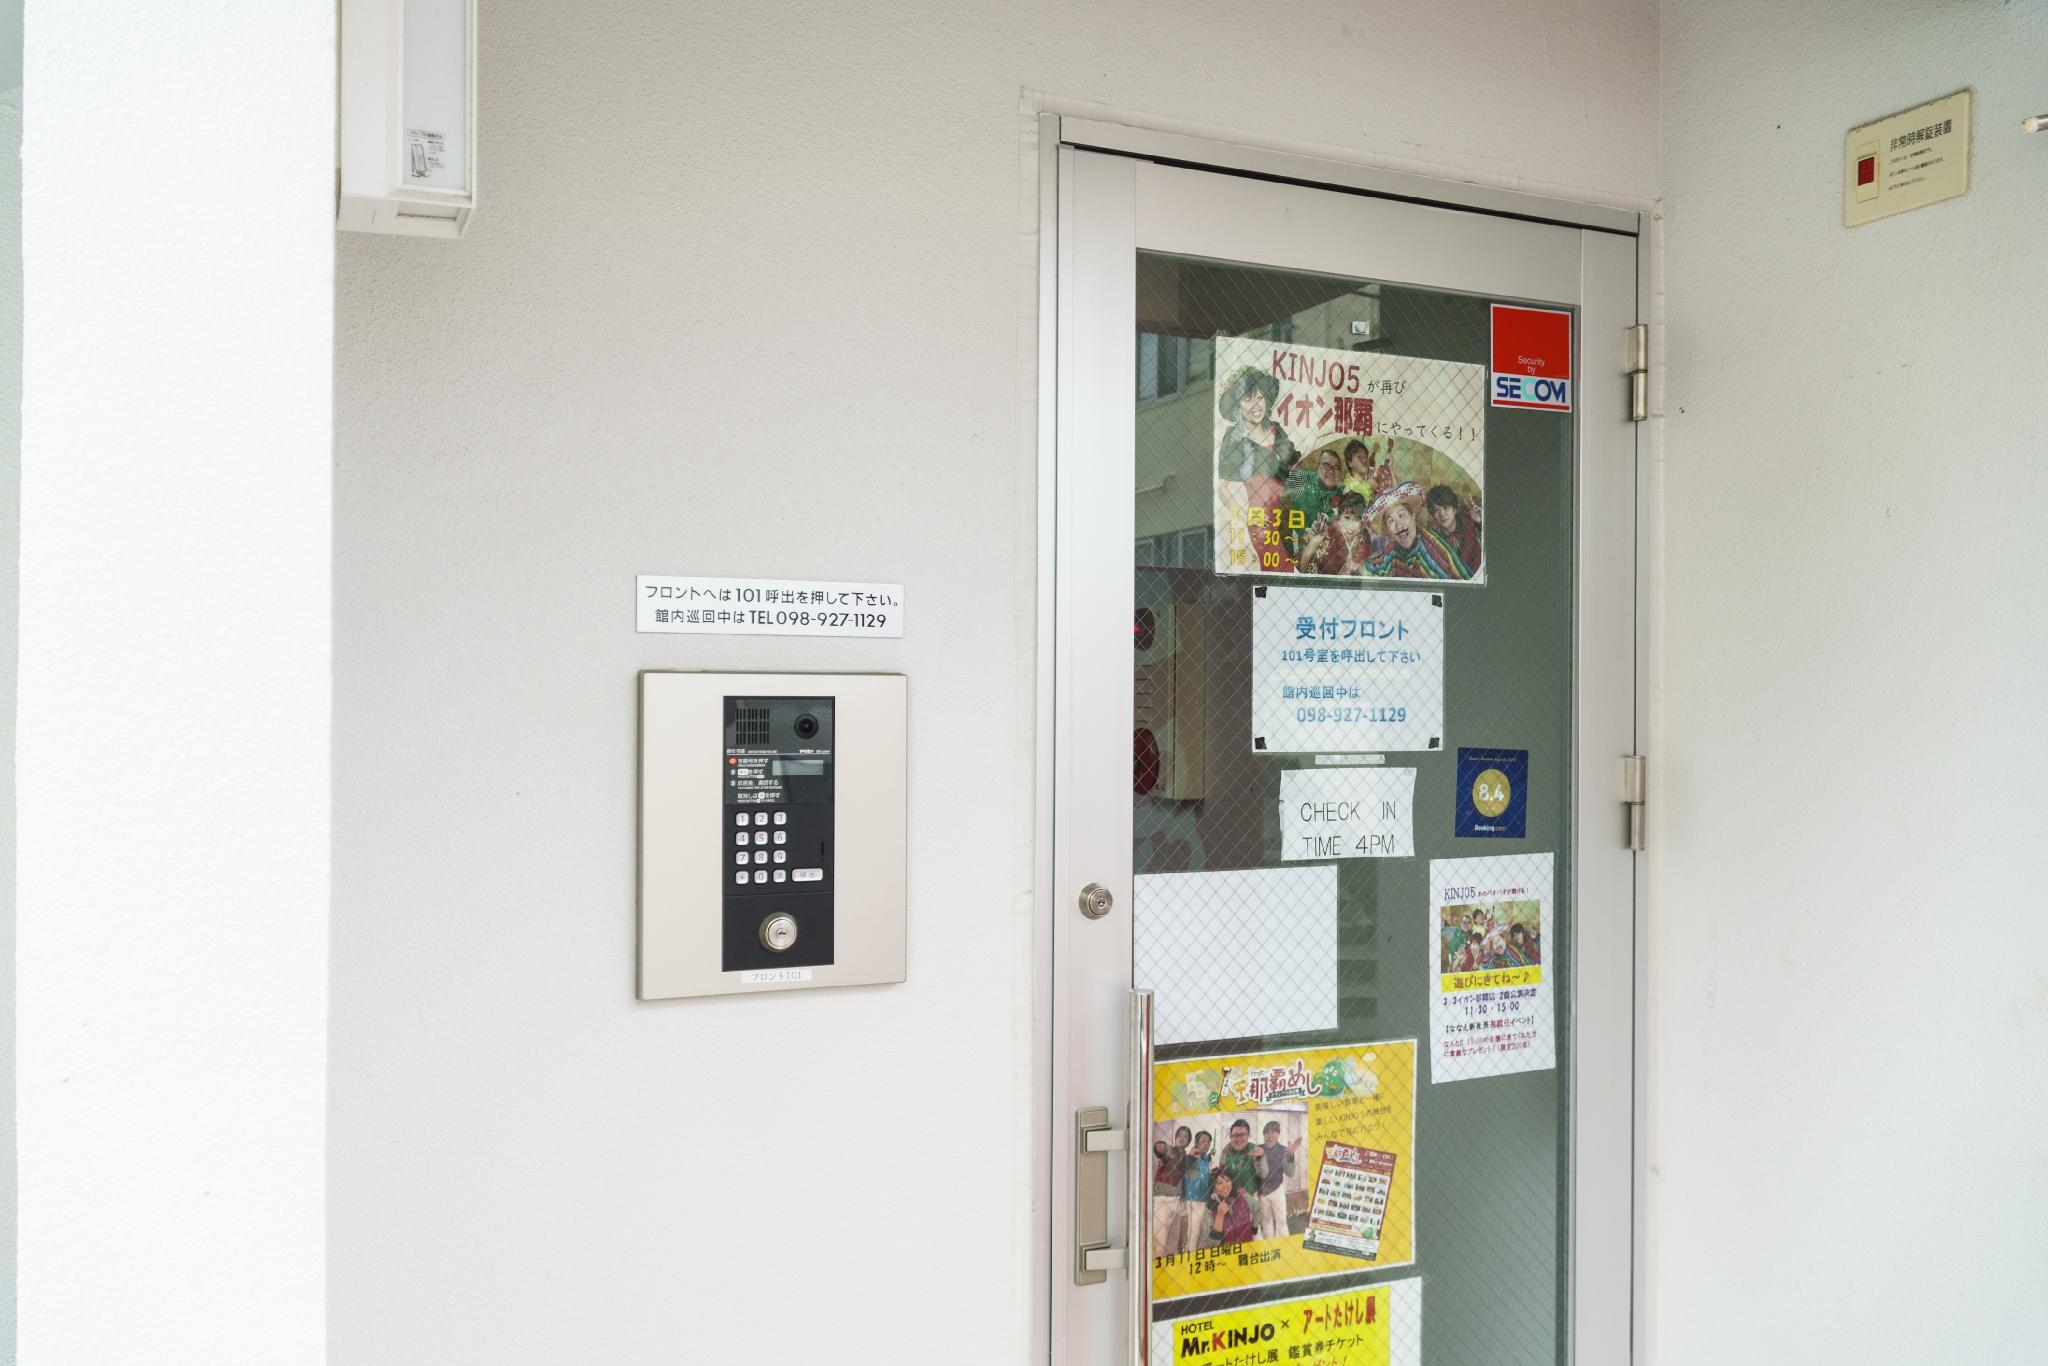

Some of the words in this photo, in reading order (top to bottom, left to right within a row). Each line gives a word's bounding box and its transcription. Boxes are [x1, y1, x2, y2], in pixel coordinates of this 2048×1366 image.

[1517, 355, 1546, 367] Security
[1527, 366, 1537, 375] by
[1272, 350, 1360, 393] KINJO5
[1366, 379, 1407, 395] が再び
[1496, 376, 1566, 404] SECOM
[1276, 392, 1374, 437] イオン那覇
[644, 585, 899, 608] フロントへは101呼出を押して下さい。
[1295, 616, 1410, 641] 受付フロント
[1280, 648, 1421, 664] 101号室を呼出して下さい
[1282, 685, 1361, 700] 館内巡回中は
[1296, 706, 1407, 723] 098-927-1129
[1478, 783, 1505, 801] 8.4
[1300, 801, 1361, 822] CHECK
[1382, 801, 1397, 820] IN
[1302, 835, 1342, 857] TIME
[1355, 834, 1395, 855] 4PM
[1444, 886, 1476, 901] KINJO5
[1180, 1320, 1215, 1336] HOTEL
[1288, 1334, 1364, 1360] 鑑賞券チケット
